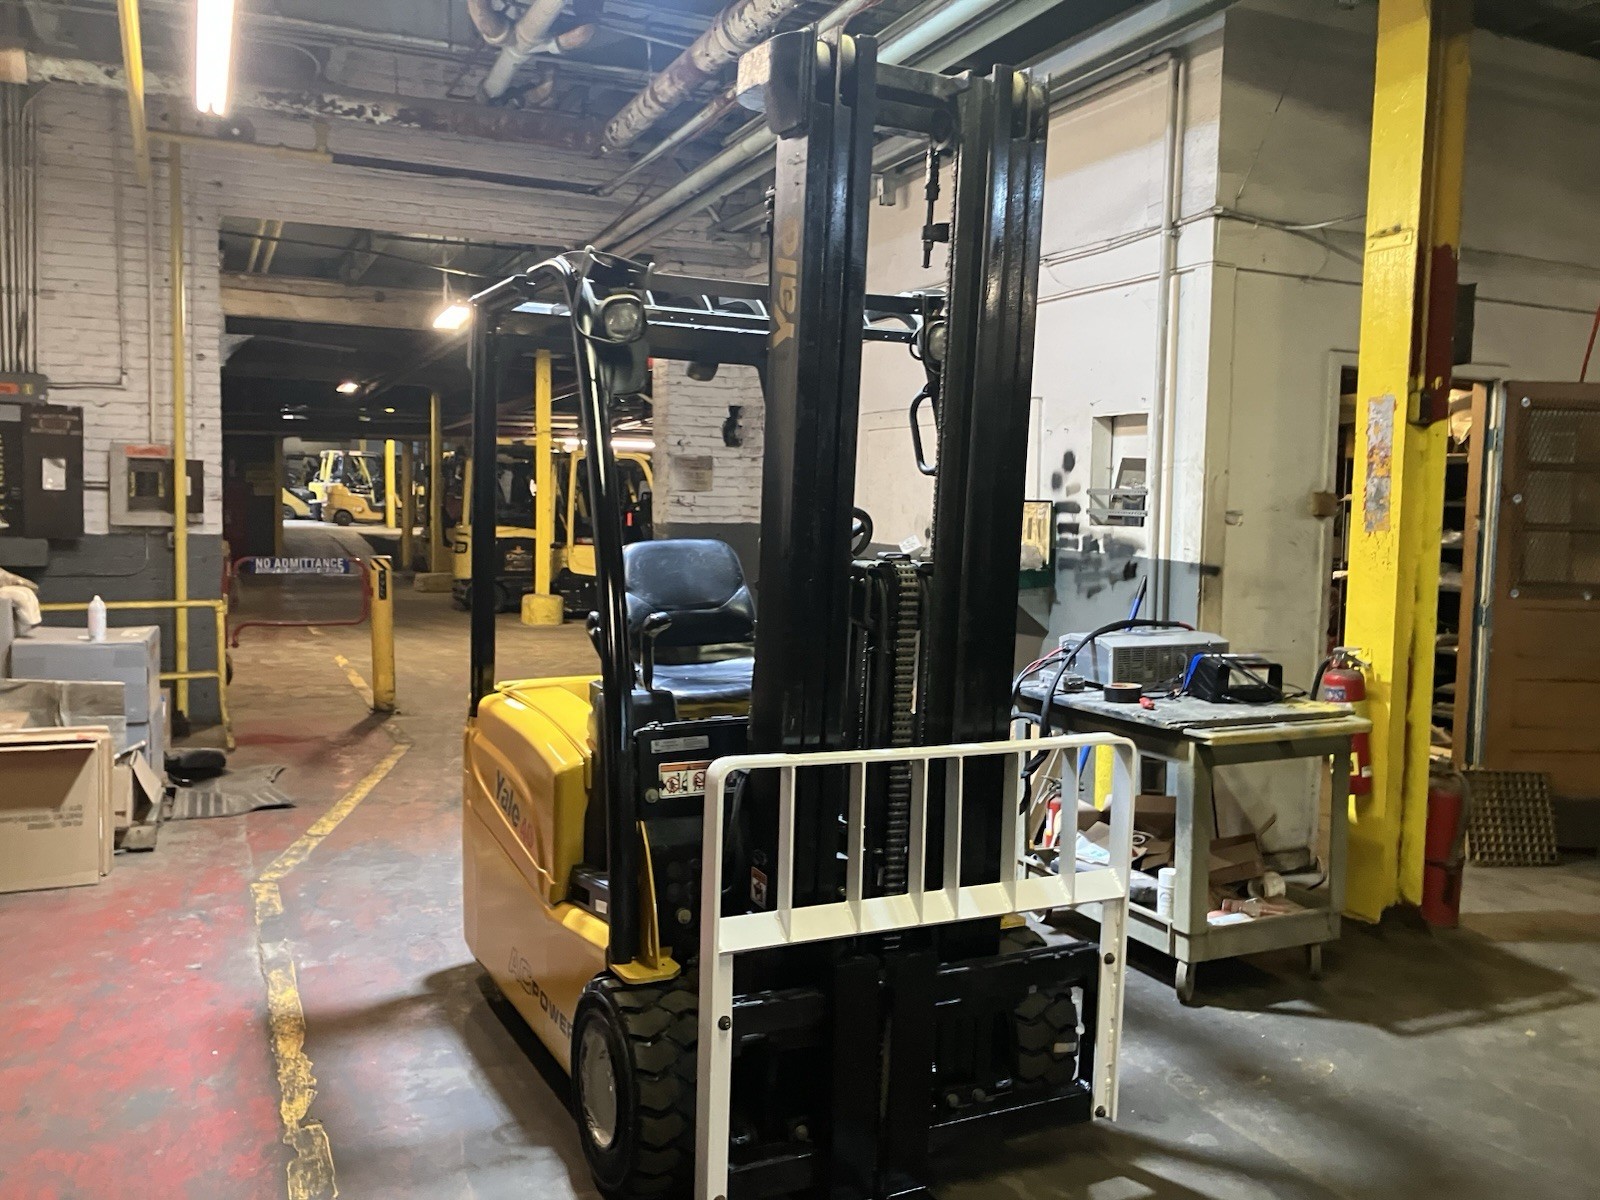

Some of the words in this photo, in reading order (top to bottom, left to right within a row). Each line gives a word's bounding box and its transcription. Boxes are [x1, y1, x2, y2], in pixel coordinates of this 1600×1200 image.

[255, 557, 271, 568] NO
[274, 557, 344, 568] ADMITTANCE
[496, 769, 520, 828] Yale
